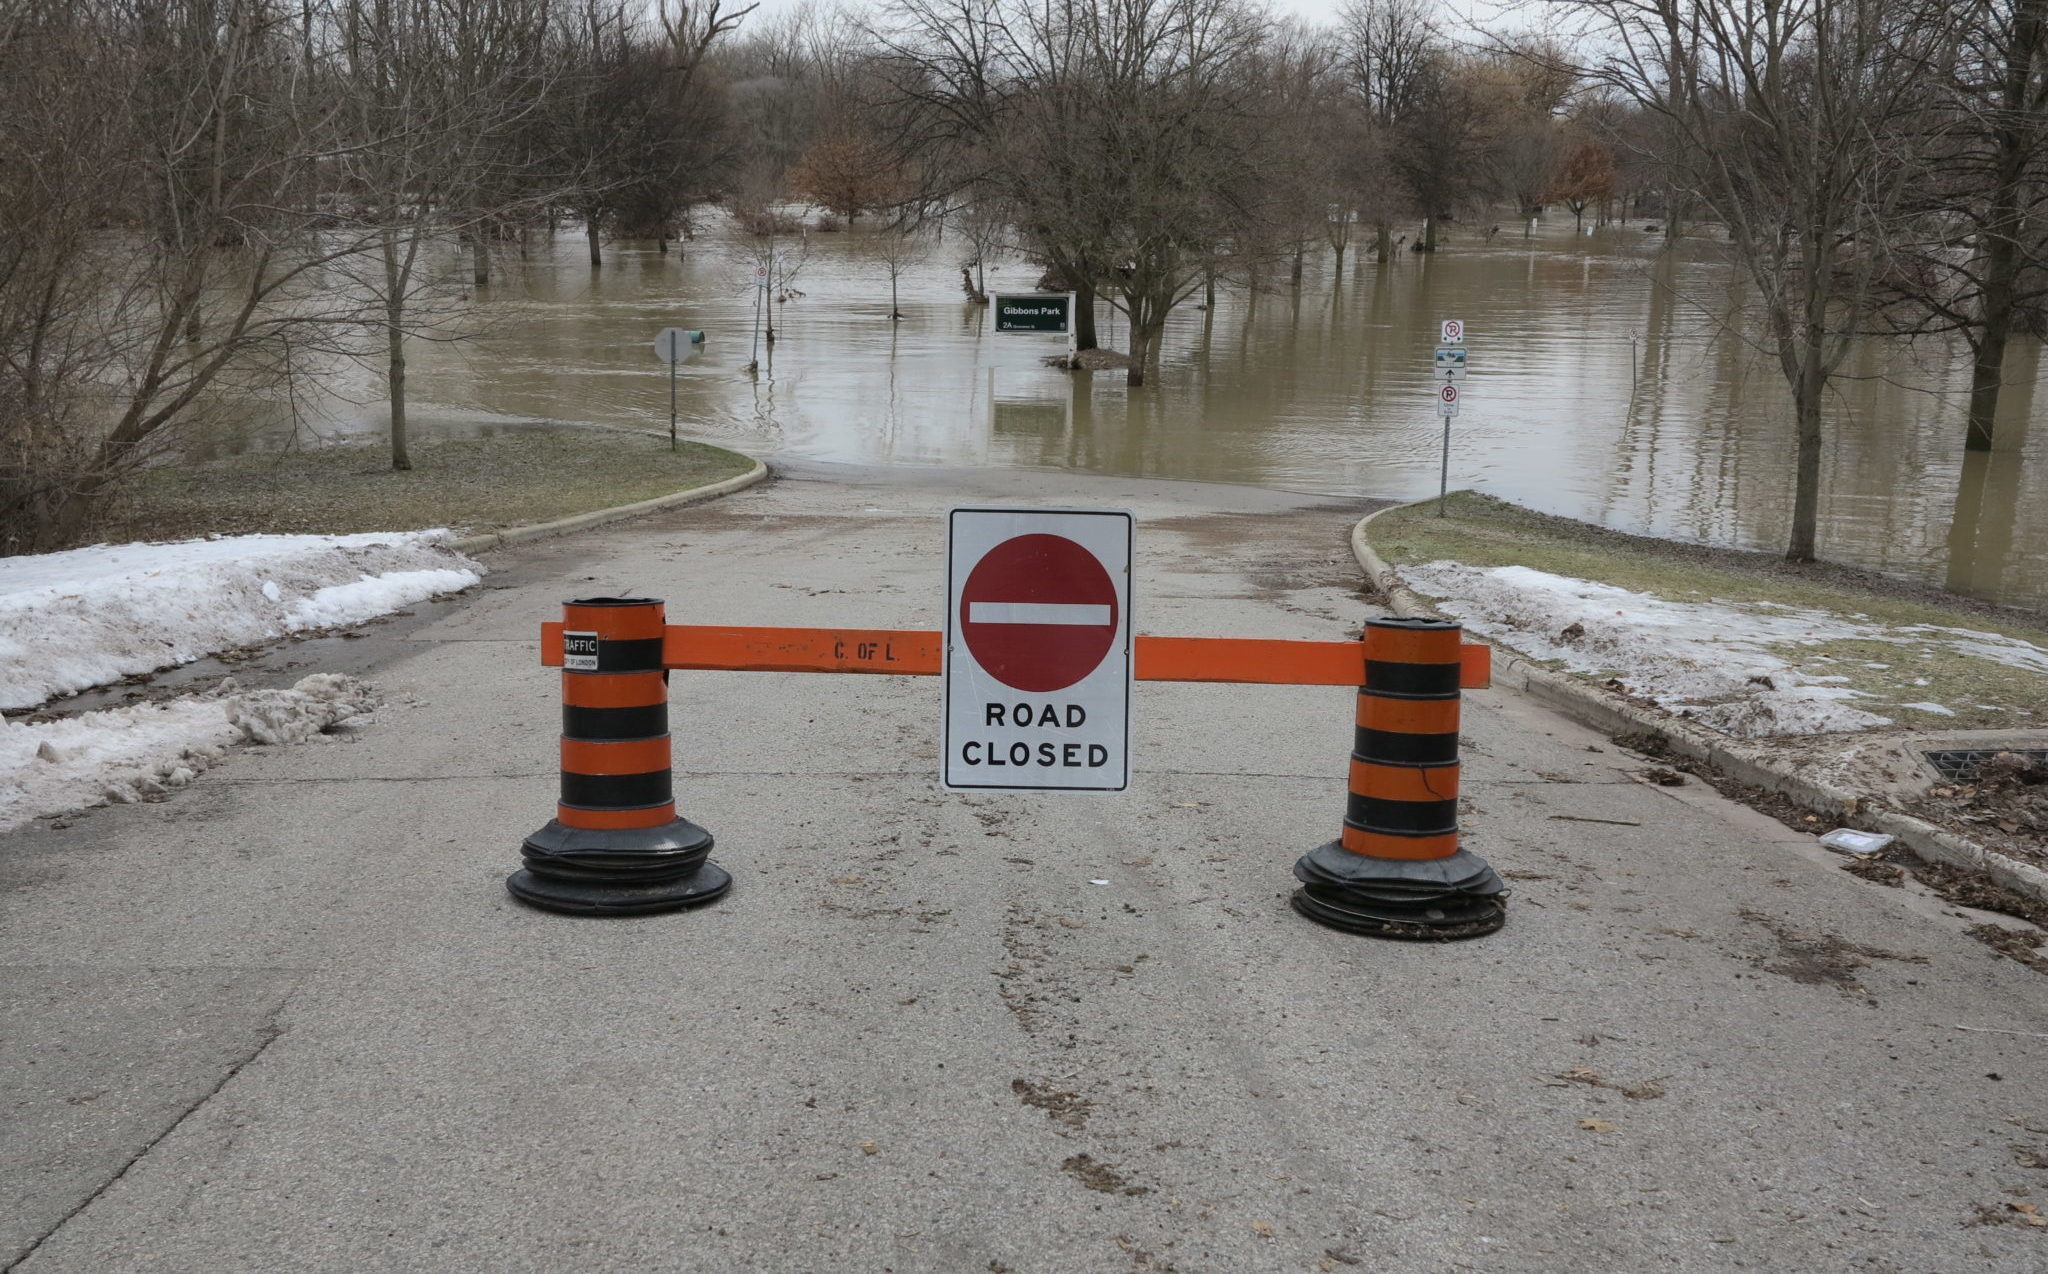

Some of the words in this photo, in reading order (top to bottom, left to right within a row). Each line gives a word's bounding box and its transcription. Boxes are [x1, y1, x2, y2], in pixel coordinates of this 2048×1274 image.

[1003, 307, 1039, 315] Gibbons
[1041, 307, 1060, 315] Park
[1002, 321, 1013, 329] 2A
[857, 642, 878, 660] OF
[985, 702, 1086, 728] ROAD
[962, 741, 1108, 767] CLOSED
